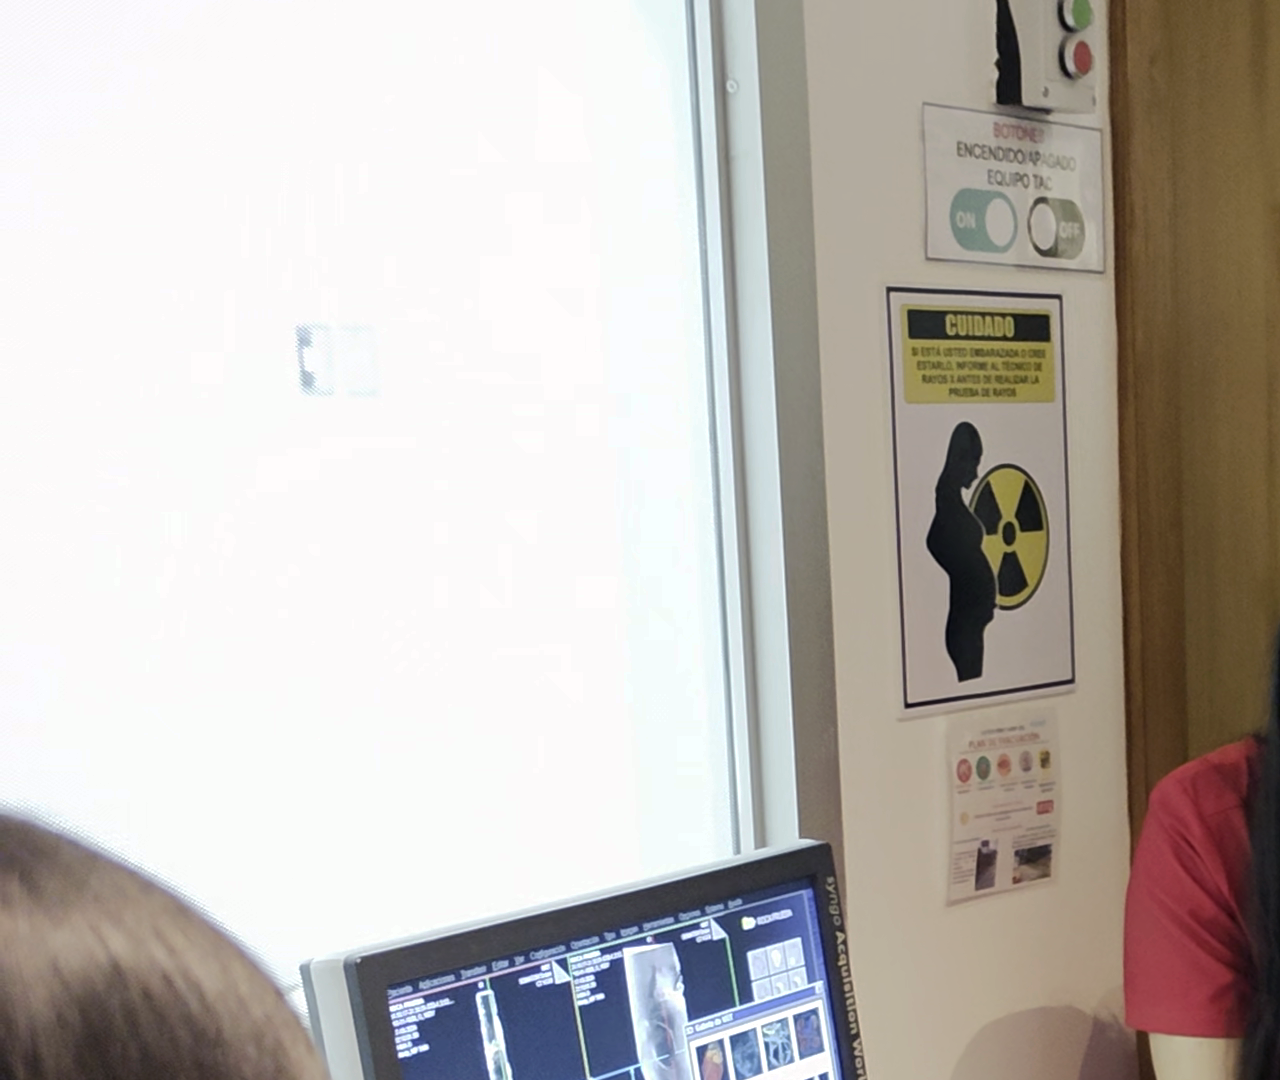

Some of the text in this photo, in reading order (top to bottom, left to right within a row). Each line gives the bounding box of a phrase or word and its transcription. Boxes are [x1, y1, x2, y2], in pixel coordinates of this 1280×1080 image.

[987, 168, 1053, 191] EQUIPO TAC
[955, 211, 1082, 239] ON OFF
[945, 313, 1015, 338] CUIDADO
[943, 347, 968, 358] USTED
[970, 347, 1019, 359] EMBARAZADA
[956, 361, 988, 372] INFORME
[1033, 361, 1043, 372] DE
[922, 374, 948, 384] RAYOS
[957, 374, 981, 385] ANTES
[982, 374, 992, 384] DE
[948, 387, 979, 398] PRUEBA
[981, 387, 990, 398] DE
[825, 876, 843, 927] syngo
[834, 930, 859, 1036] Acquisition
